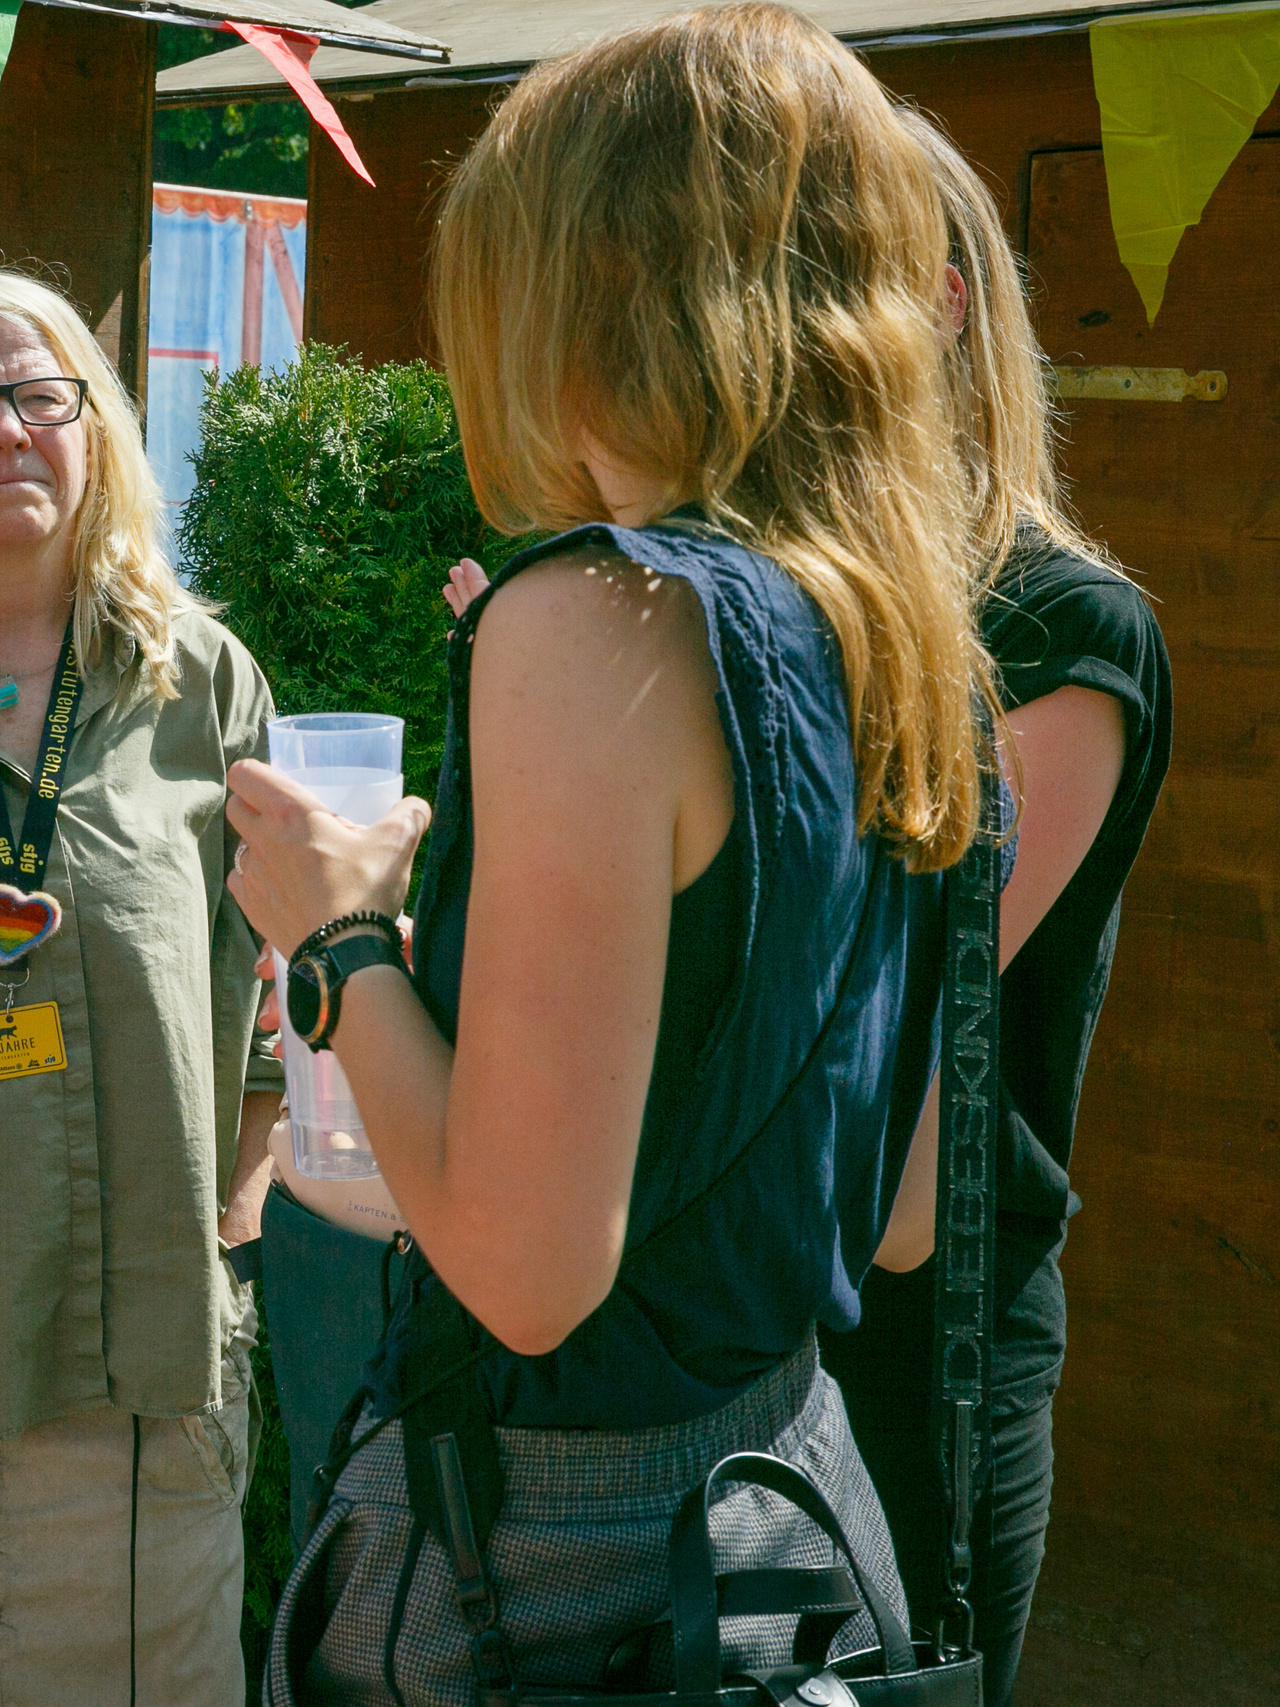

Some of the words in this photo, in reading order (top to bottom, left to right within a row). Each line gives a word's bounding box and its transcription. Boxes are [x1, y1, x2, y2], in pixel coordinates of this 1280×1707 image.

[38, 638, 78, 799] .stutengarten.de
[0, 1037, 36, 1053] JAHRE
[354, 1204, 387, 1218] KAPTEN
[390, 1213, 396, 1221] &
